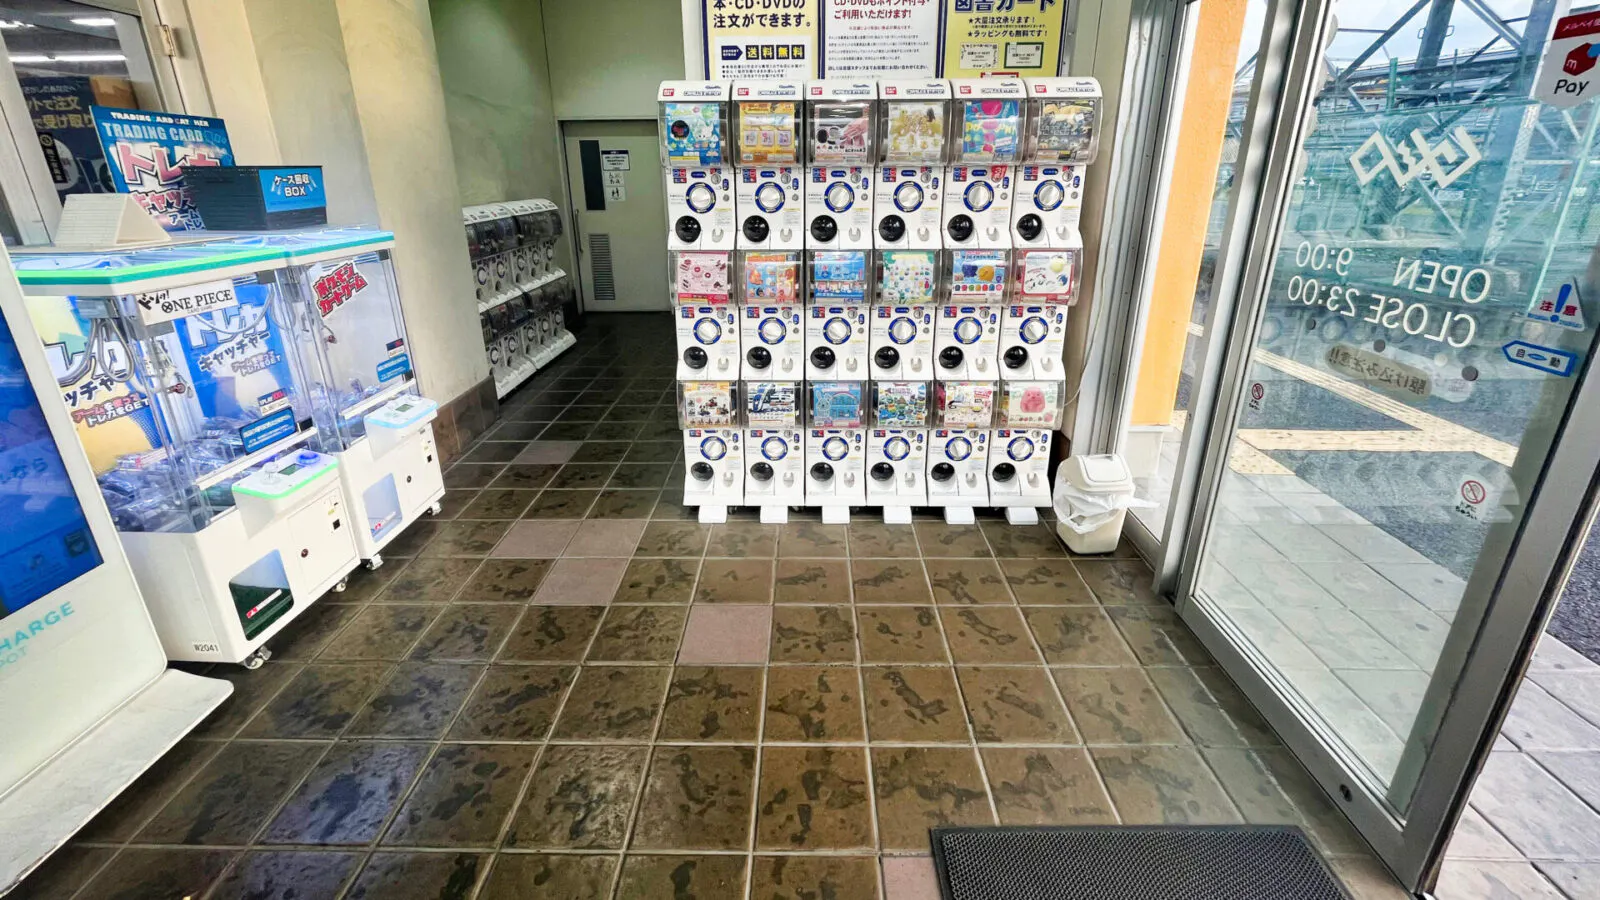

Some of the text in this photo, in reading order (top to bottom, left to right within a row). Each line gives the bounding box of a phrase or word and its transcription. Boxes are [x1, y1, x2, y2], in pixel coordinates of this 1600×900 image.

[714, 13, 811, 28] 注文ができます。
[1553, 79, 1590, 97] Pay
[110, 111, 152, 123] TRADING
[101, 122, 168, 140] TRADING
[169, 127, 204, 142] CARD
[285, 186, 307, 198] BOX
[314, 263, 355, 299] ポケモン
[161, 289, 234, 313] ONE PIECE
[199, 331, 271, 371] キャッチャー
[193, 644, 220, 653] W2041
